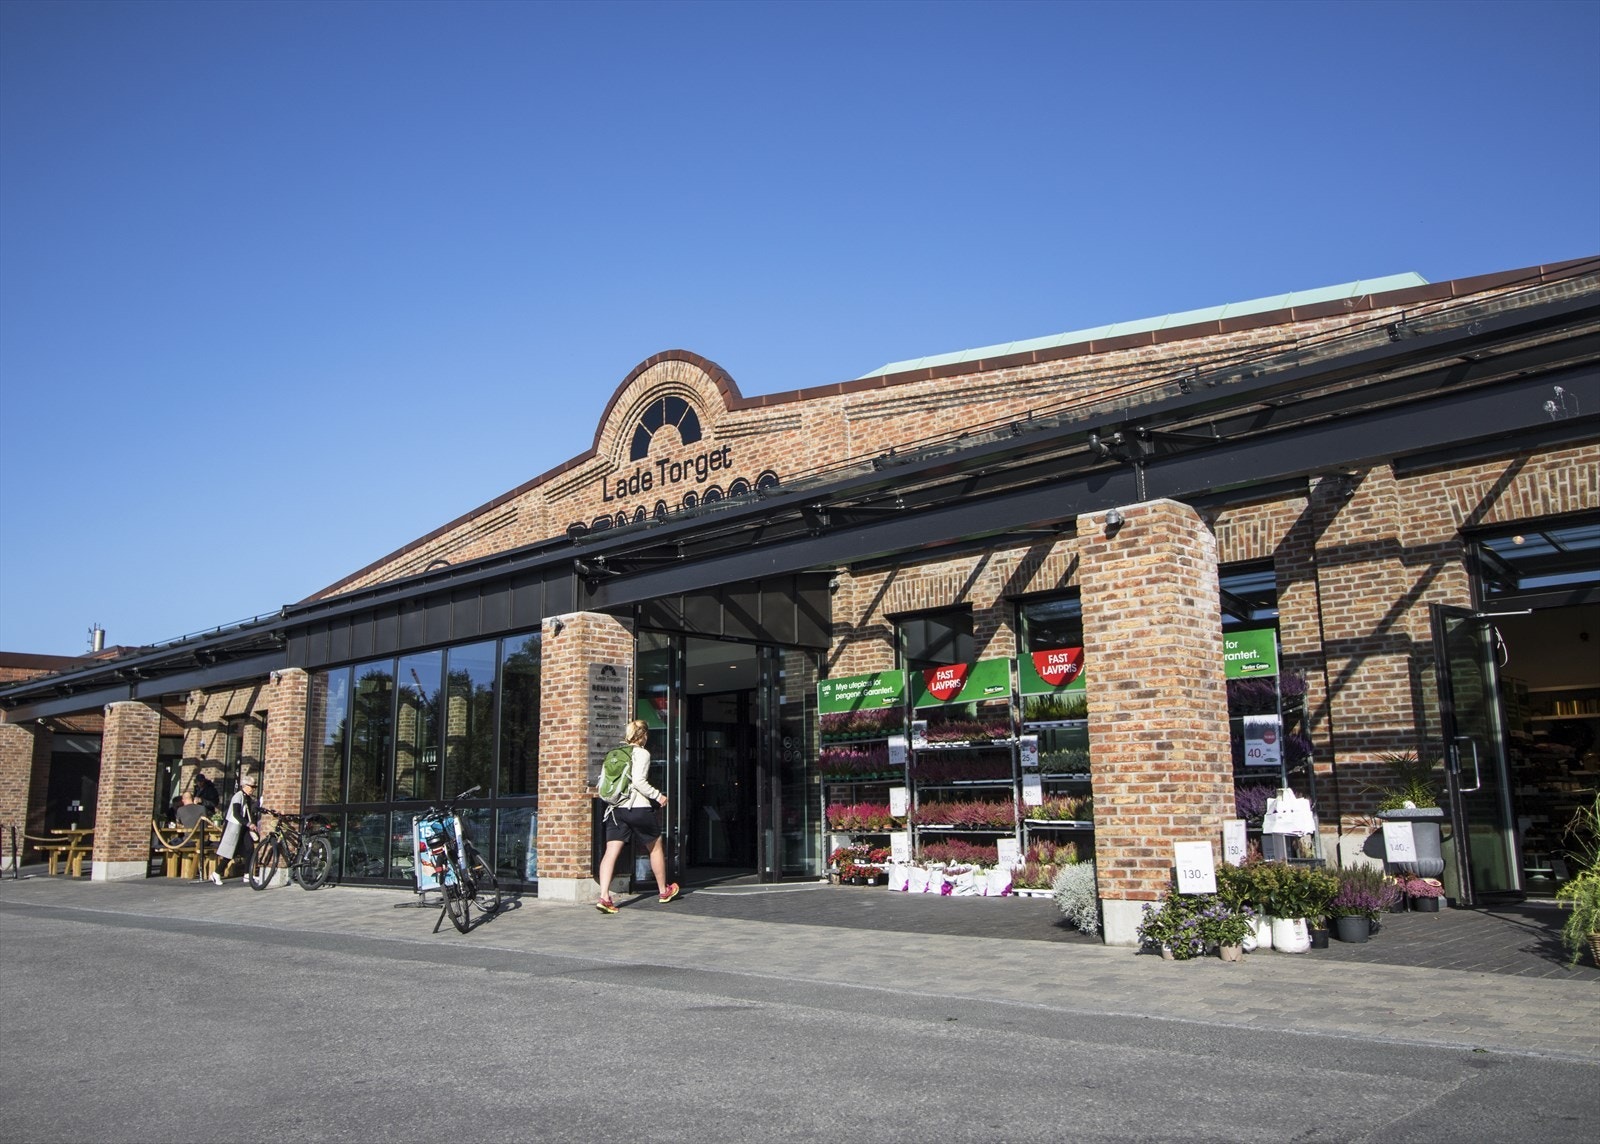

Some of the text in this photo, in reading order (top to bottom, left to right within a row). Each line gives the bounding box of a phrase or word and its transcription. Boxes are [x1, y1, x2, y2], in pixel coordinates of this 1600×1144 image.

[603, 467, 653, 502] Lade
[656, 444, 733, 486] Torget
[1225, 640, 1239, 649] for
[1048, 653, 1068, 664] FAST
[1224, 649, 1260, 661] rantert.
[936, 669, 954, 680] FAST
[1042, 663, 1078, 676] LAVPRIS
[835, 683, 848, 691] Mye
[931, 679, 961, 691] LAVPRIS
[1247, 748, 1266, 758] 40,-
[1183, 869, 1208, 879] 130,-
